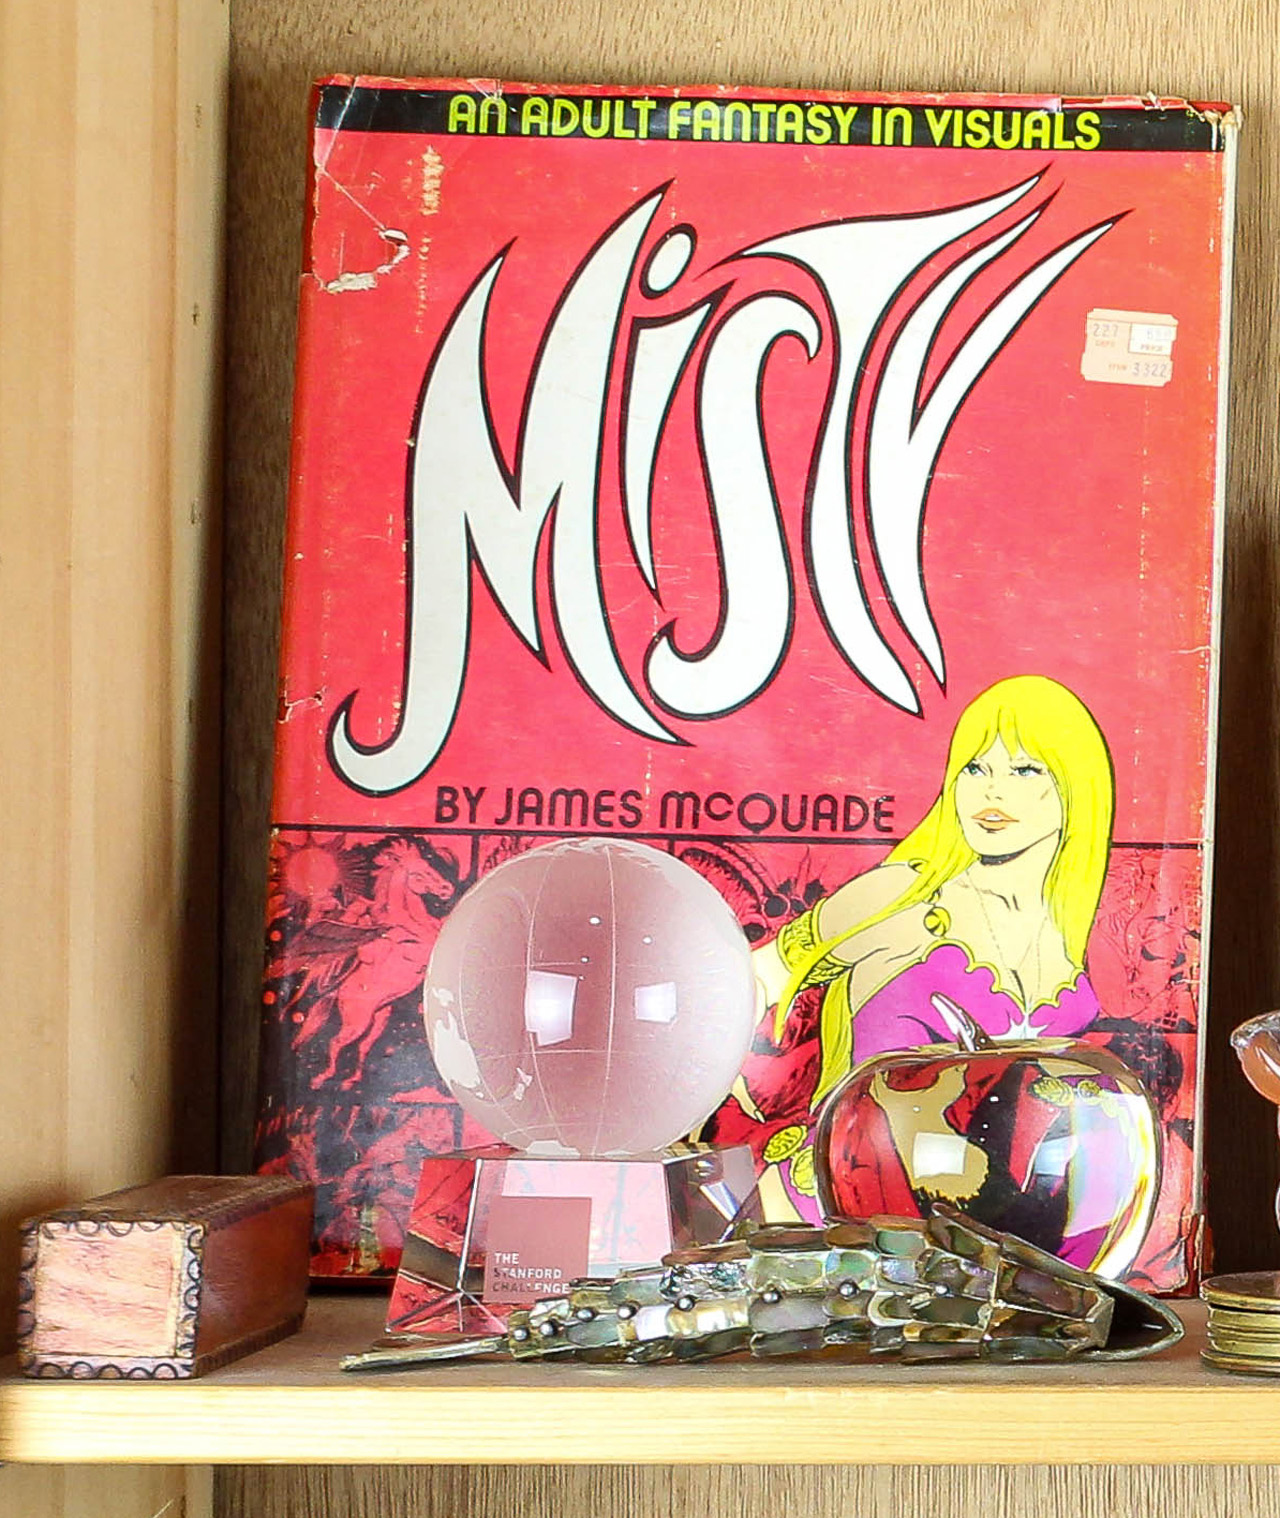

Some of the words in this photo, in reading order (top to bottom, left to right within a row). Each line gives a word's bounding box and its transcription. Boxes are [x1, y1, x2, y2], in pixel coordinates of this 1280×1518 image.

[448, 95, 507, 134] AN
[520, 97, 657, 139] ADULT
[668, 101, 858, 145] FANTASY
[871, 106, 914, 146] IN
[925, 109, 1101, 150] VISUALS
[434, 785, 487, 823] BY
[494, 787, 644, 829] JAMES
[494, 1252, 519, 1265] THE
[493, 1267, 562, 1279] STANFORD
[492, 1281, 571, 1294] CHALLENGE
